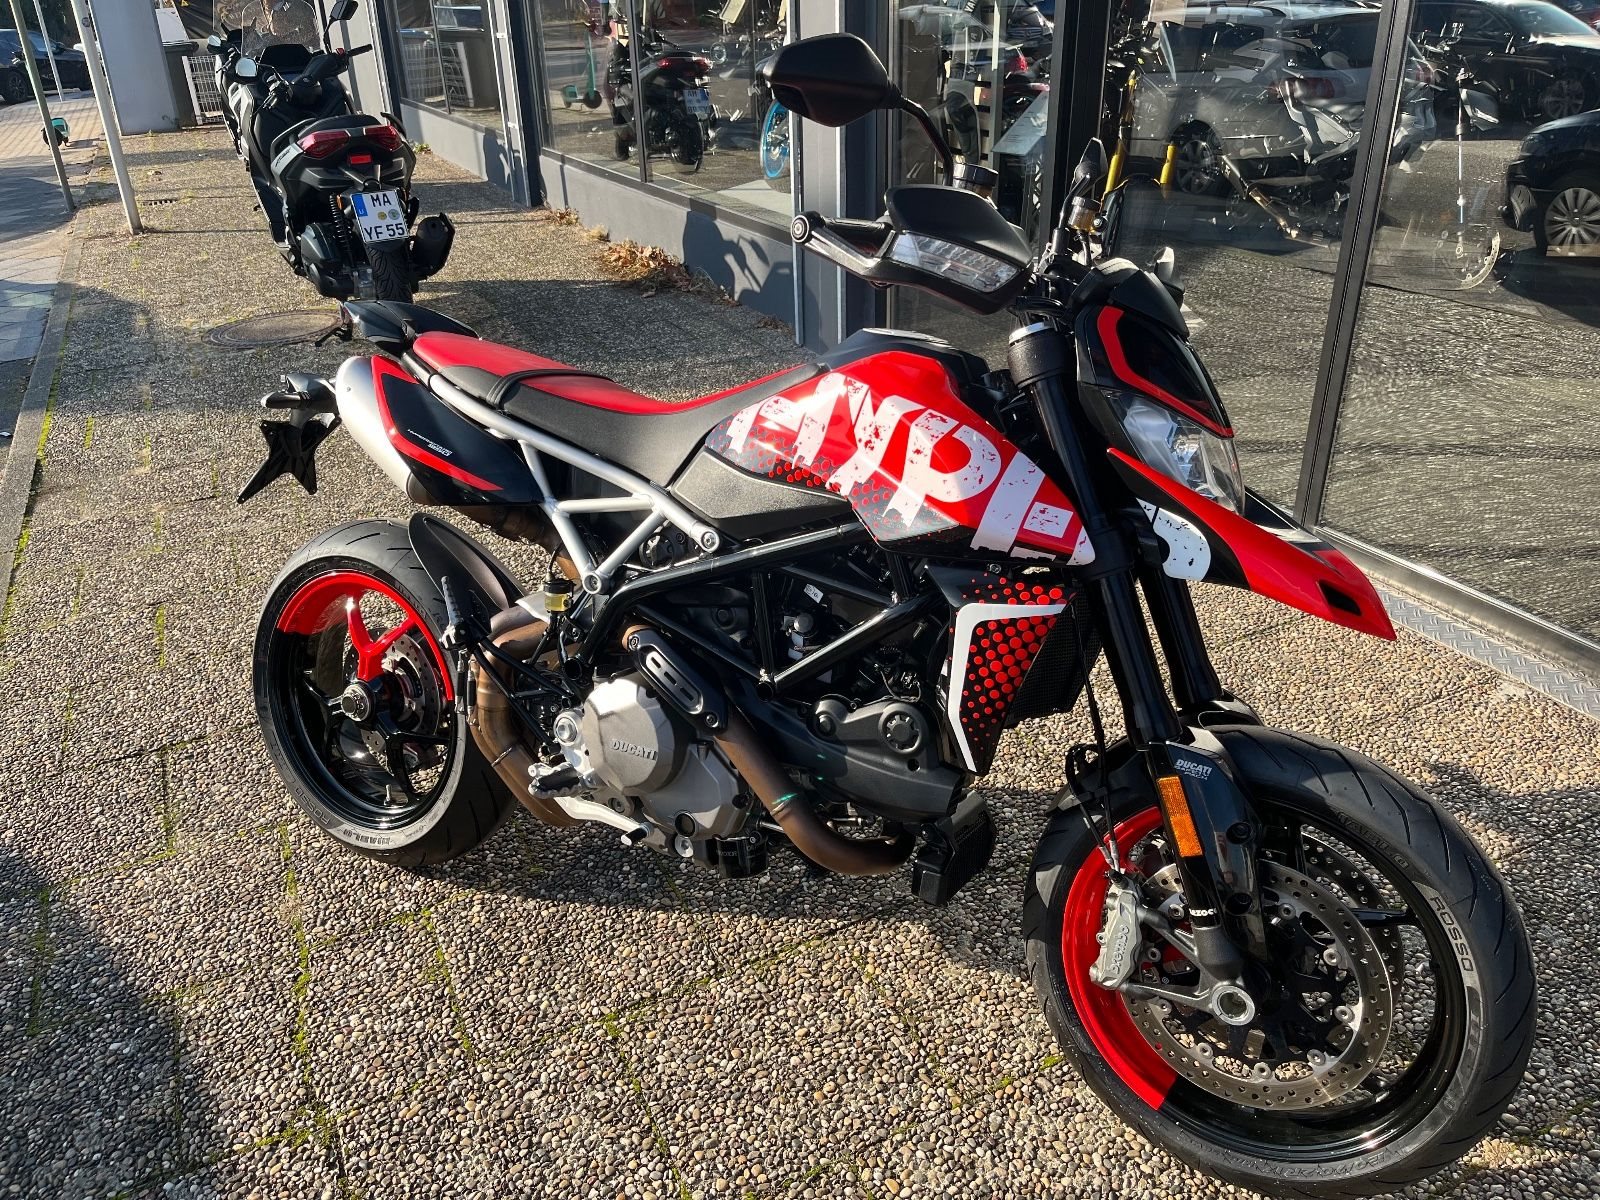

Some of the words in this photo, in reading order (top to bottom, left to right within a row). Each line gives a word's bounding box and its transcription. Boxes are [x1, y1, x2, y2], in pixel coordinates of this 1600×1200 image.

[370, 192, 392, 208] MA
[363, 225, 383, 240] YF
[385, 223, 405, 237] 55
[611, 739, 658, 761] DUCATI
[1176, 759, 1213, 774] DUCATI
[1429, 895, 1475, 973] ROSSO
[1107, 924, 1130, 975] brembo
